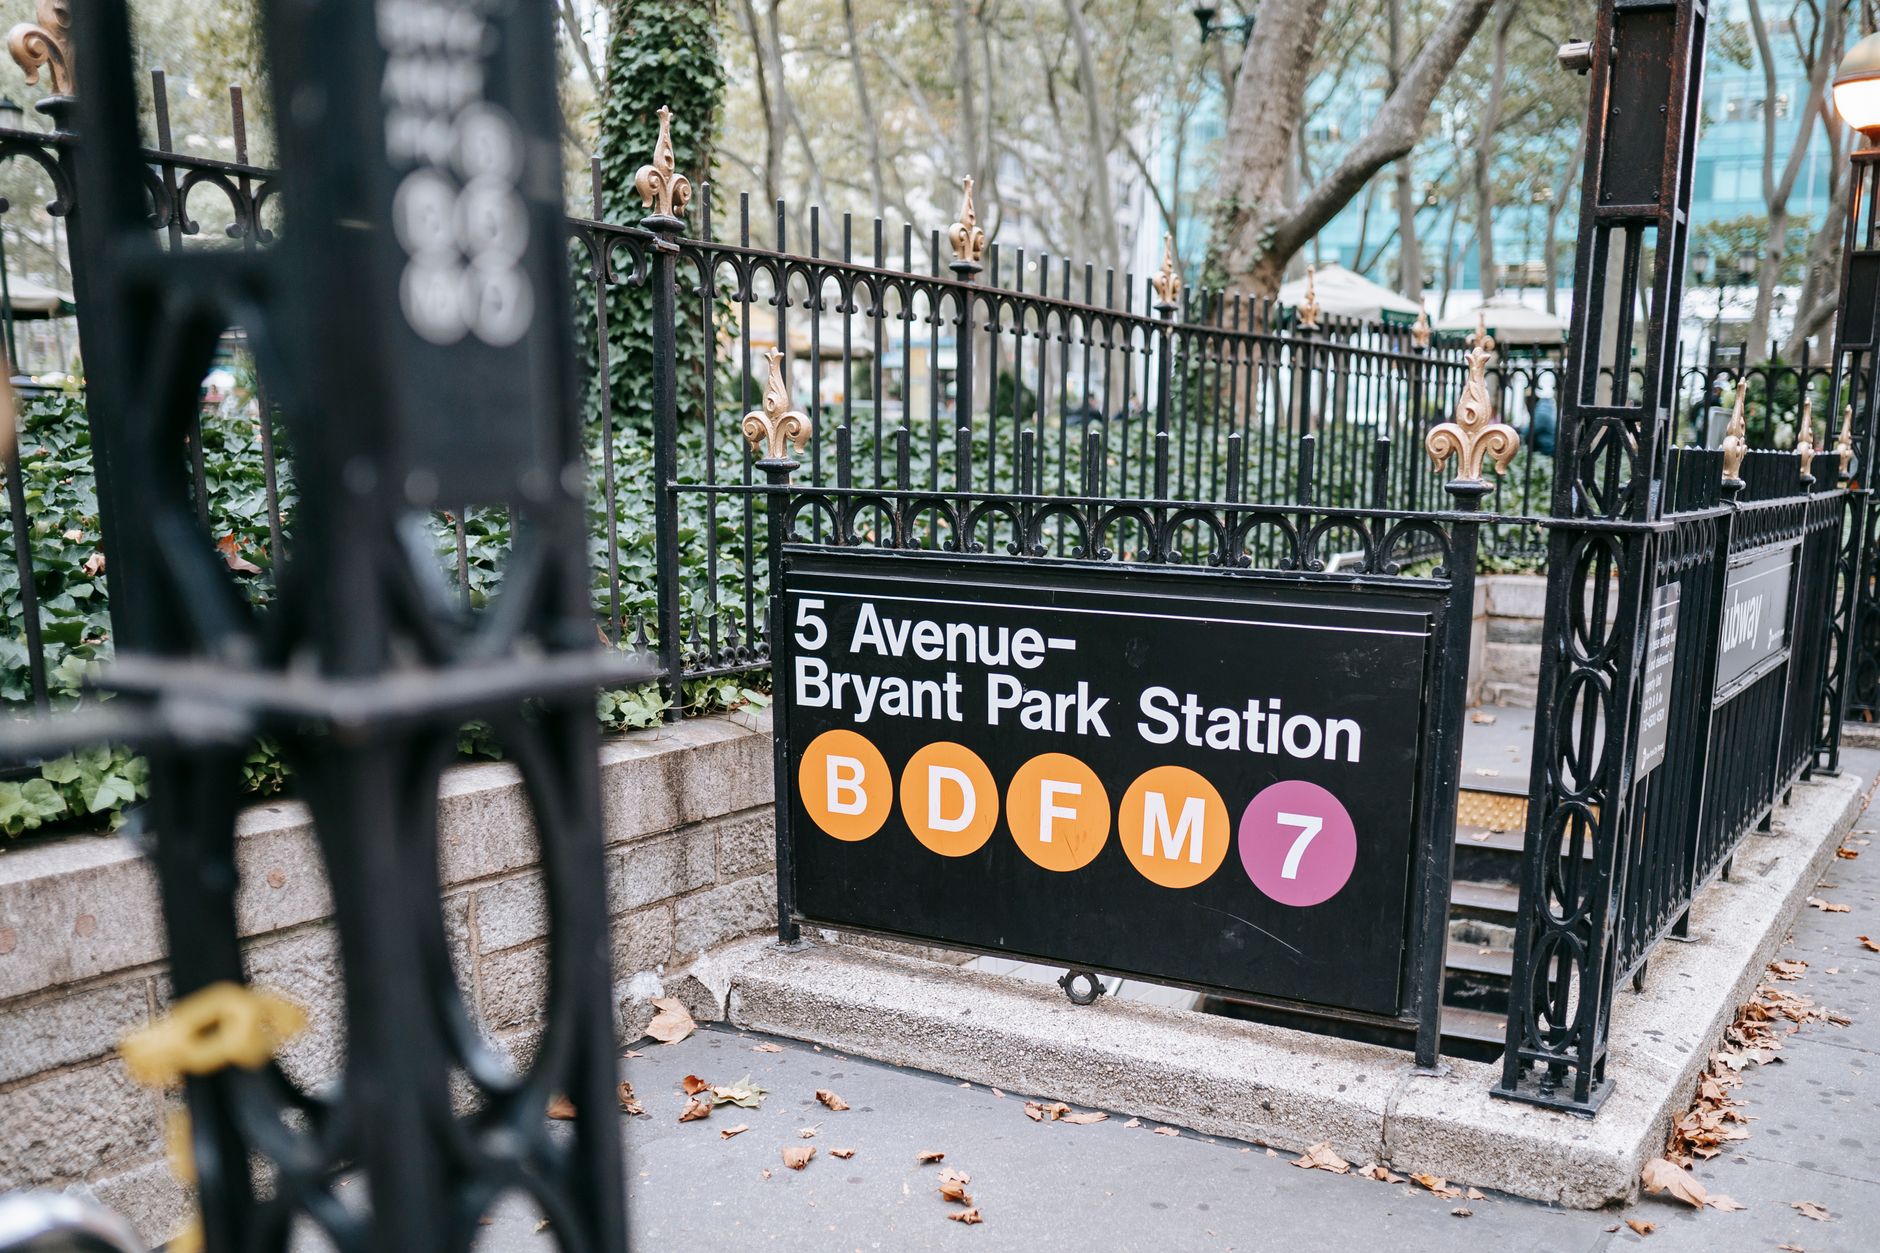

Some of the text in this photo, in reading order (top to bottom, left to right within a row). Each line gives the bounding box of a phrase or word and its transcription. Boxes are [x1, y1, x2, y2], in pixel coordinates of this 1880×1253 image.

[794, 599, 1077, 669] 5 Avenue-
[1721, 589, 1763, 653] ubway
[795, 656, 1361, 763] Bryant Park Station
[826, 754, 1324, 880] B D F M 7
